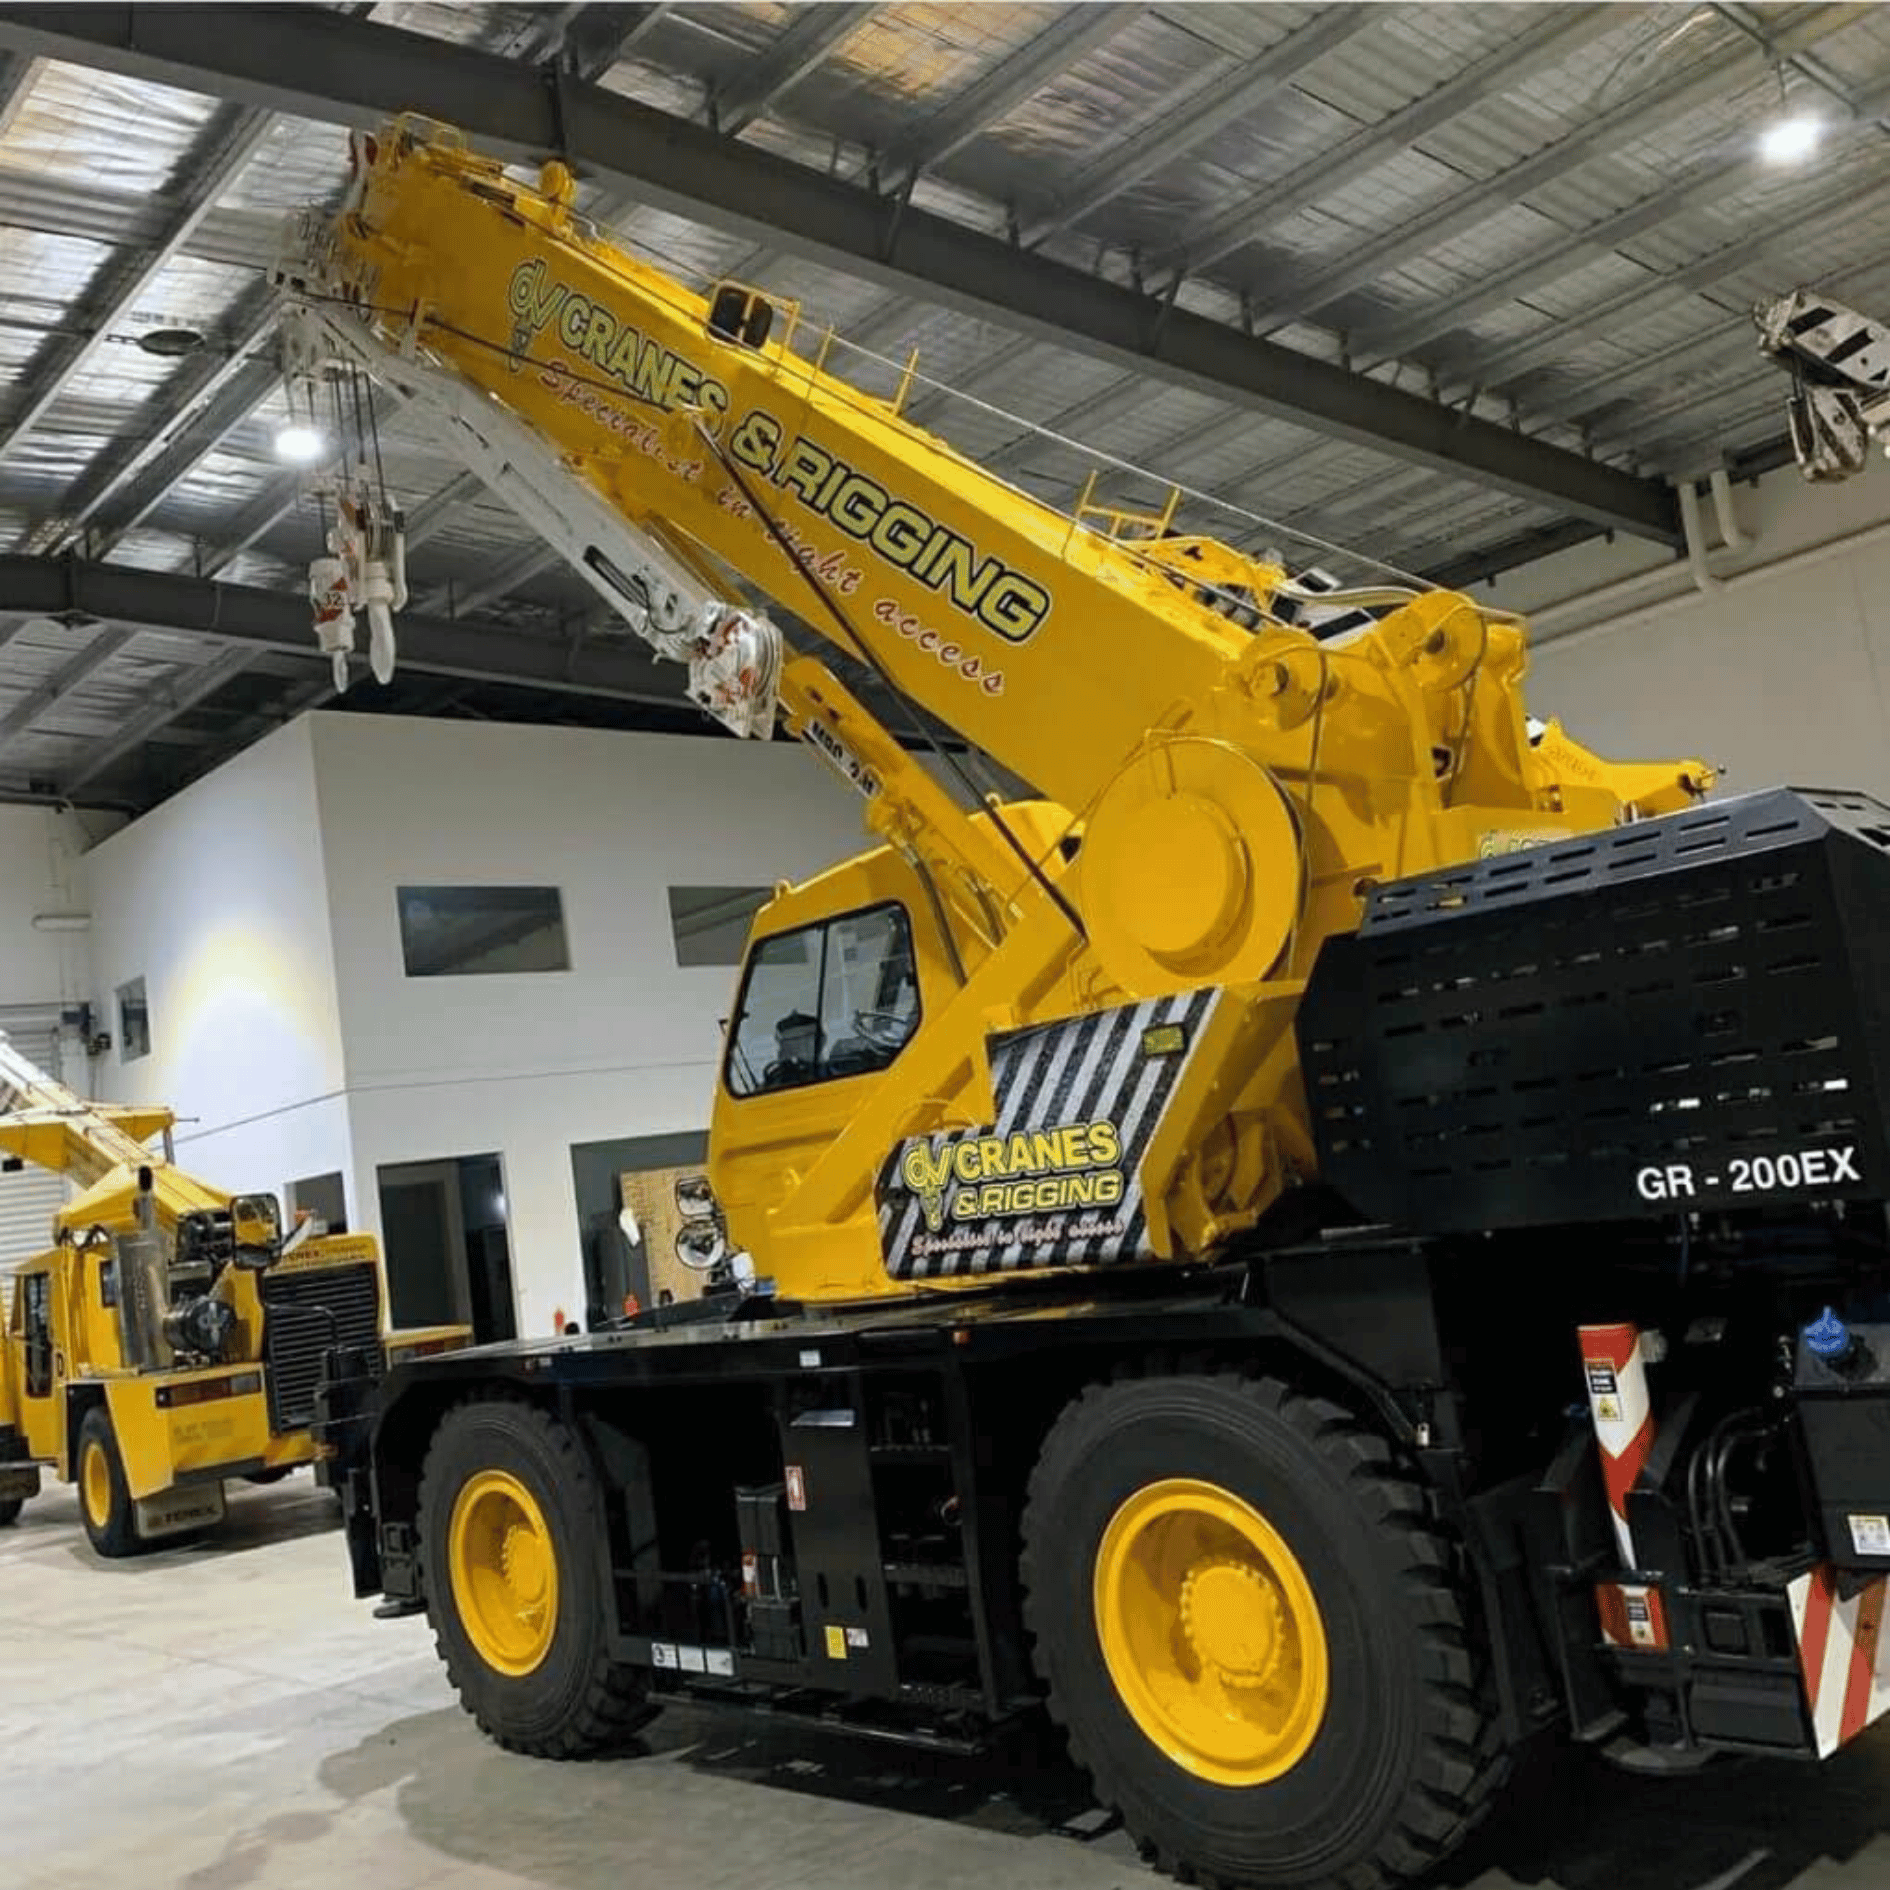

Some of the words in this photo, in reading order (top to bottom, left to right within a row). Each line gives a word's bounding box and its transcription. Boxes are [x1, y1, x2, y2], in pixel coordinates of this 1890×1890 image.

[558, 292, 729, 440] CRANES
[730, 410, 782, 481] &
[771, 435, 1051, 643] RIGGING
[873, 597, 1005, 695] access
[953, 1119, 1122, 1184] CRANES
[1636, 1164, 1696, 1200] GR
[1727, 1146, 1862, 1193] 200EX
[951, 1186, 978, 1220] &
[979, 1170, 1124, 1217] RIGGING
